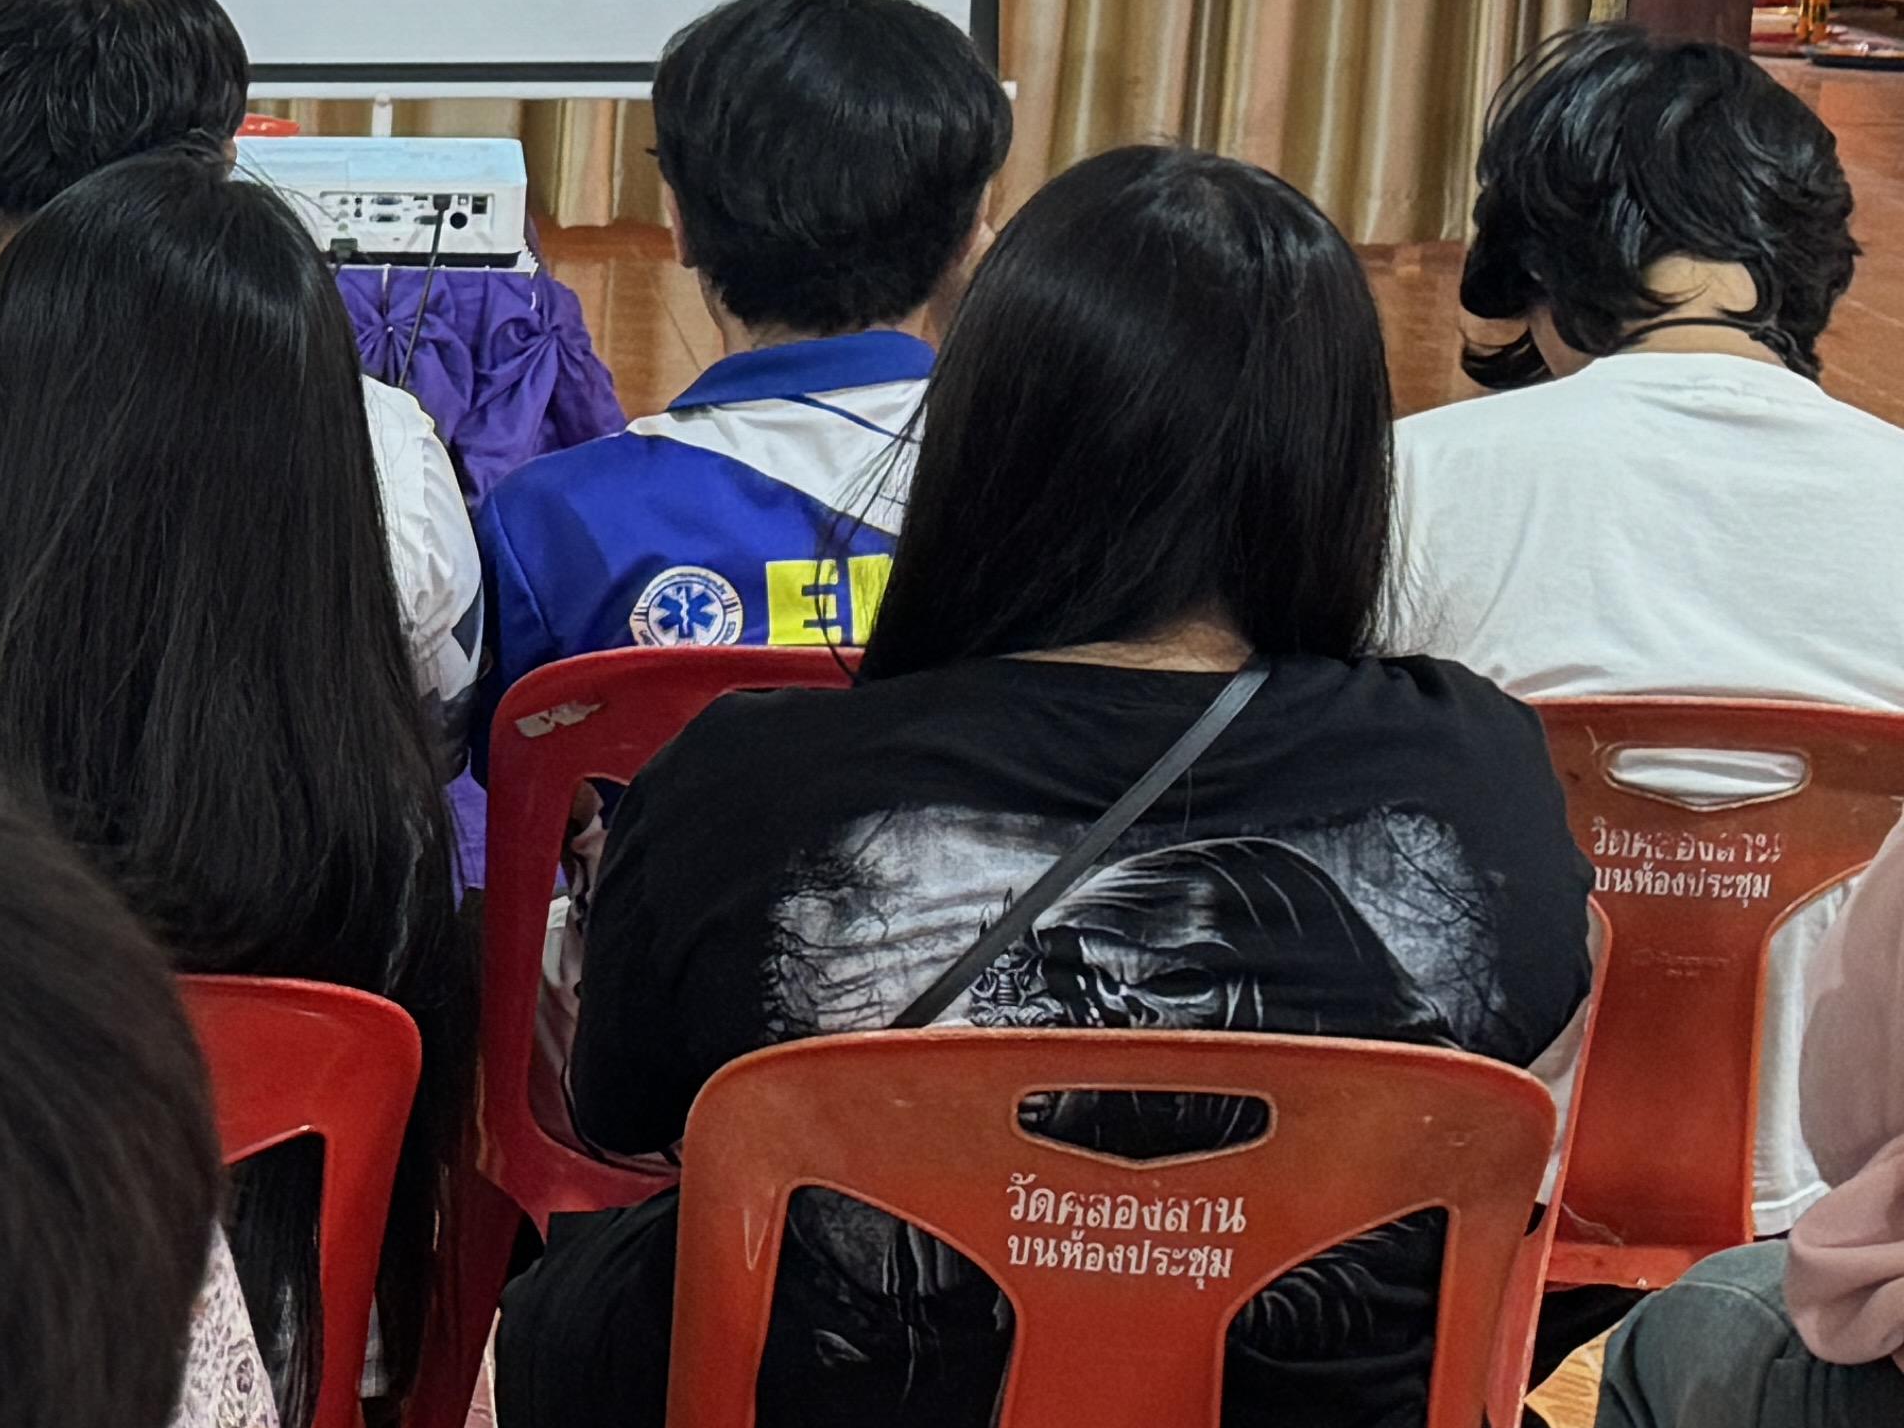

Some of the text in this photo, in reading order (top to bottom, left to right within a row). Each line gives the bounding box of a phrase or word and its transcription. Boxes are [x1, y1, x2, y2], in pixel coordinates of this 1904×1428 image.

[1008, 1228, 1234, 1290] บนห้องประชุม
